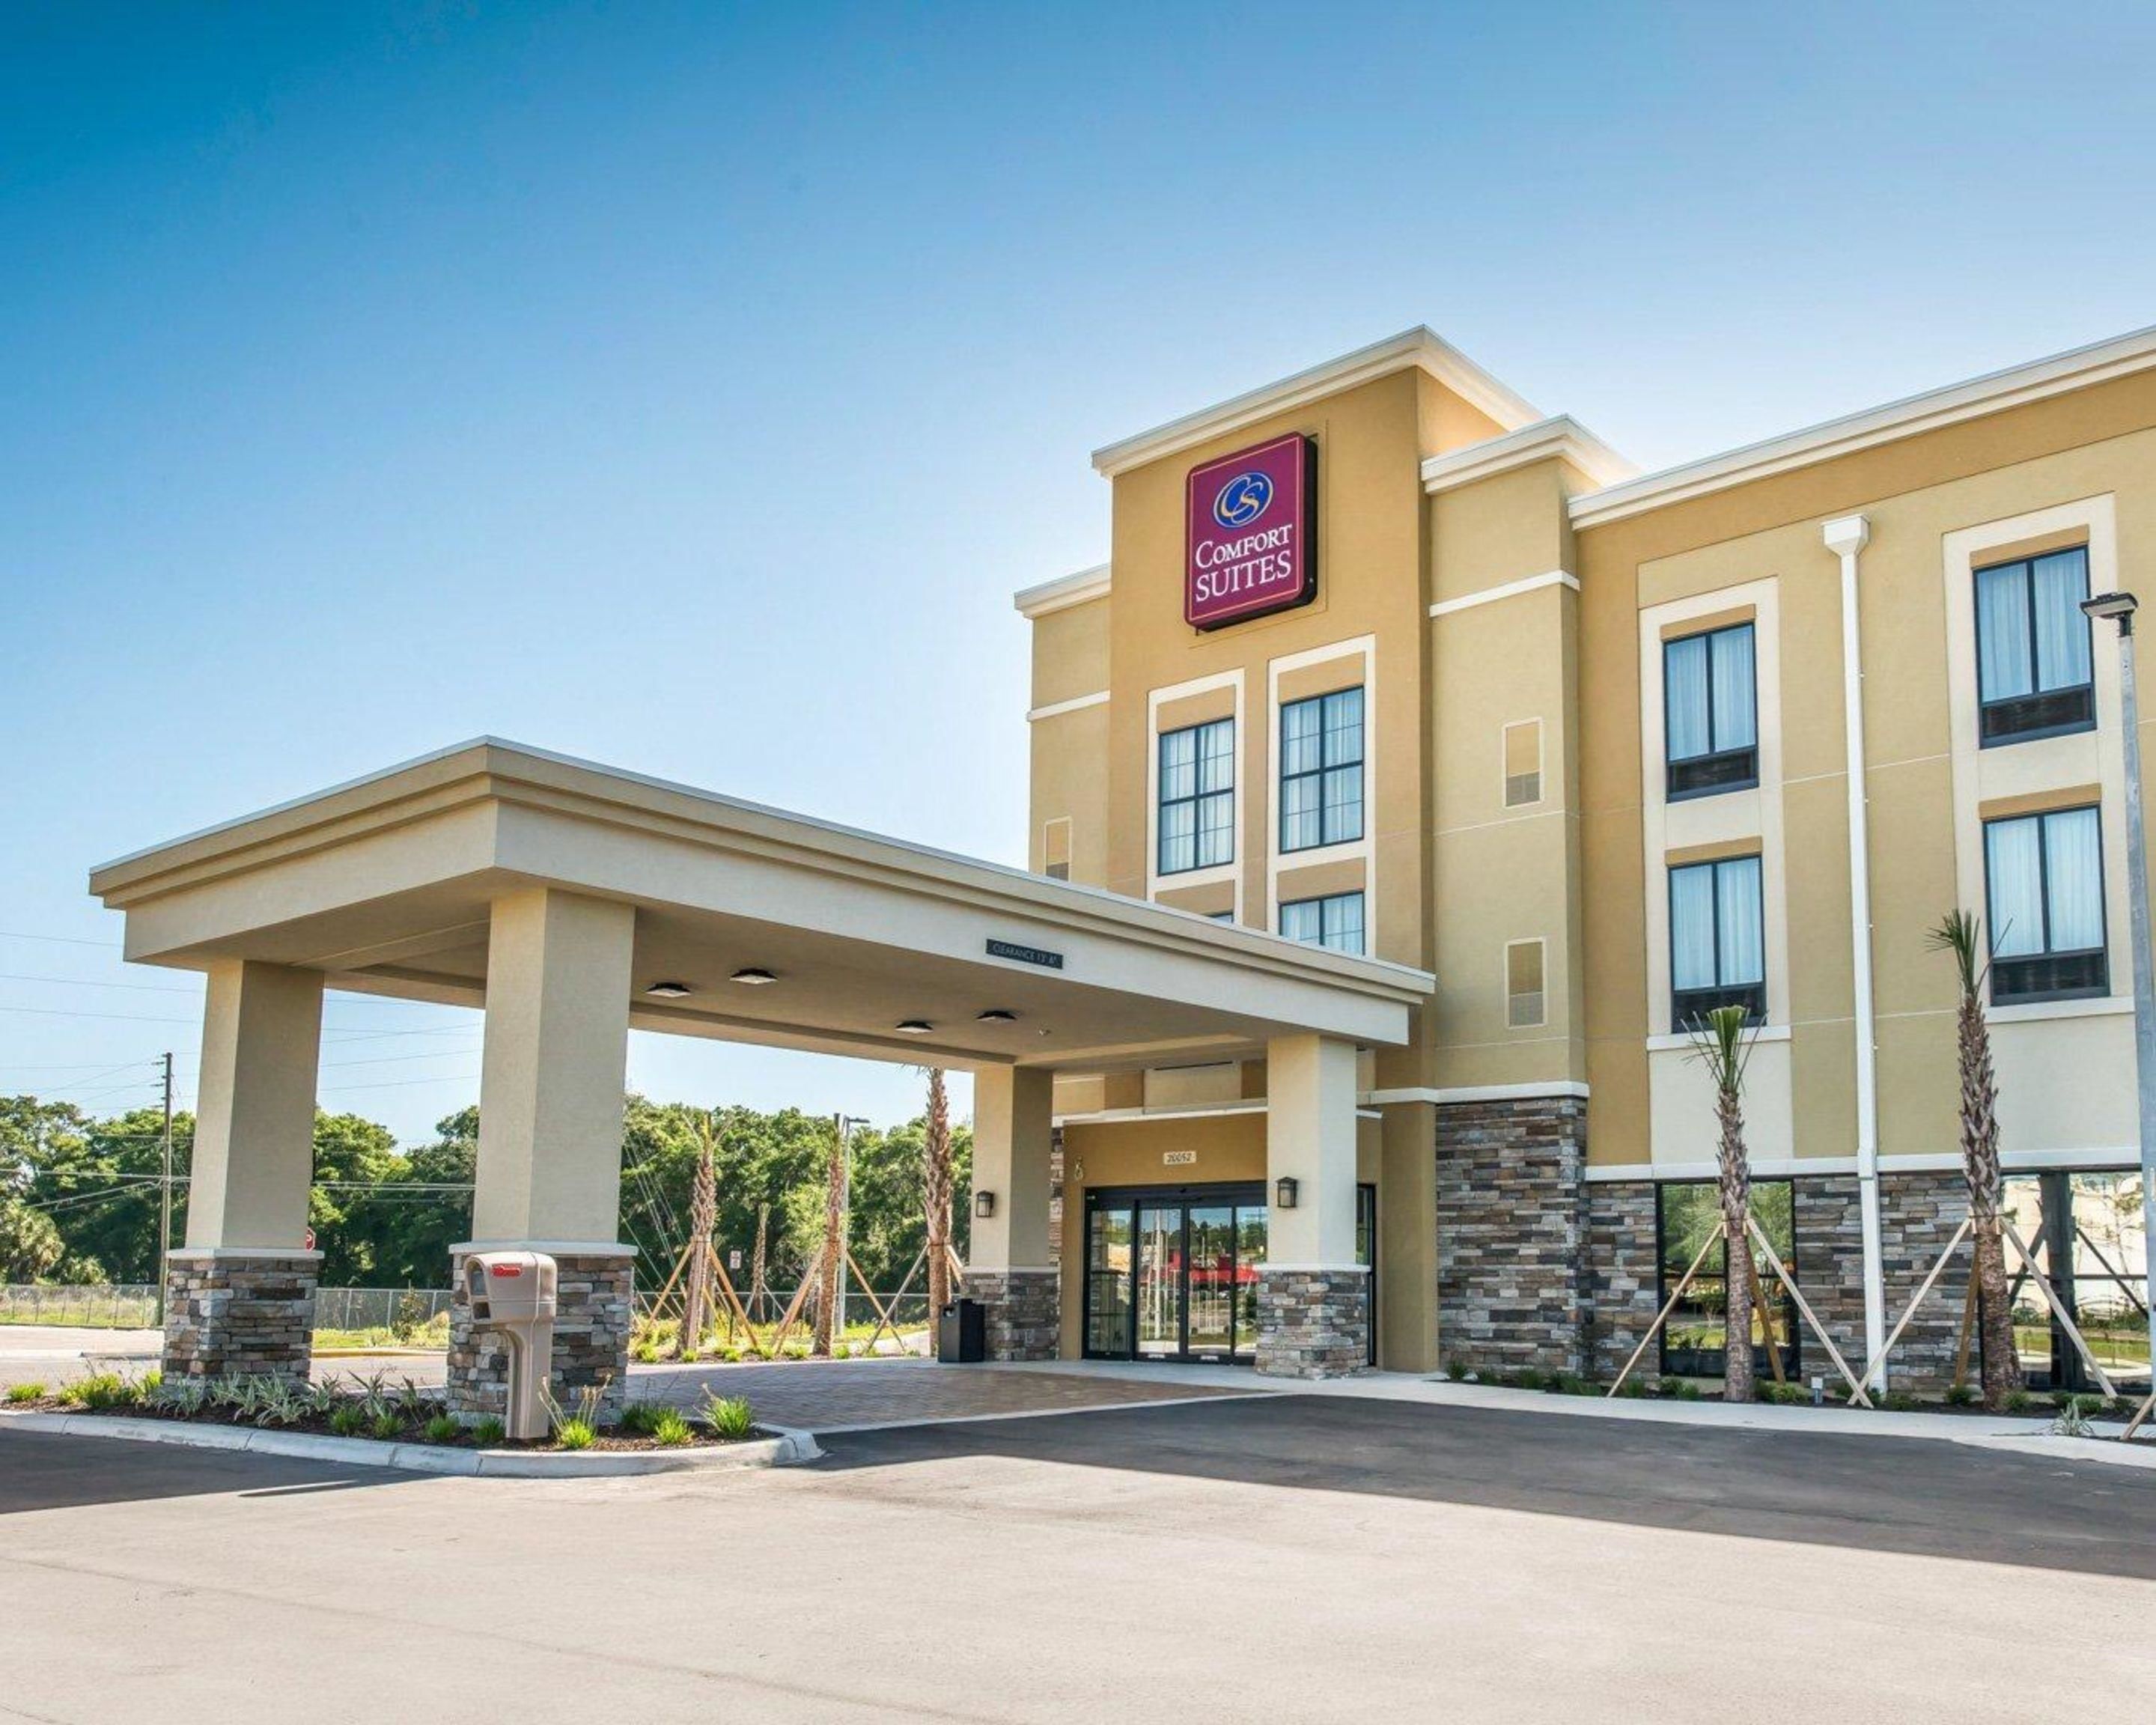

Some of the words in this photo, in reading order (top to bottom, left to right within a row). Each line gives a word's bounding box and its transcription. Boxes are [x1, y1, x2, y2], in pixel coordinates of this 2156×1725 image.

[1196, 524, 1292, 568] COMFORT
[1196, 550, 1291, 602] SUITES
[993, 943, 1035, 961] CLEARANCE
